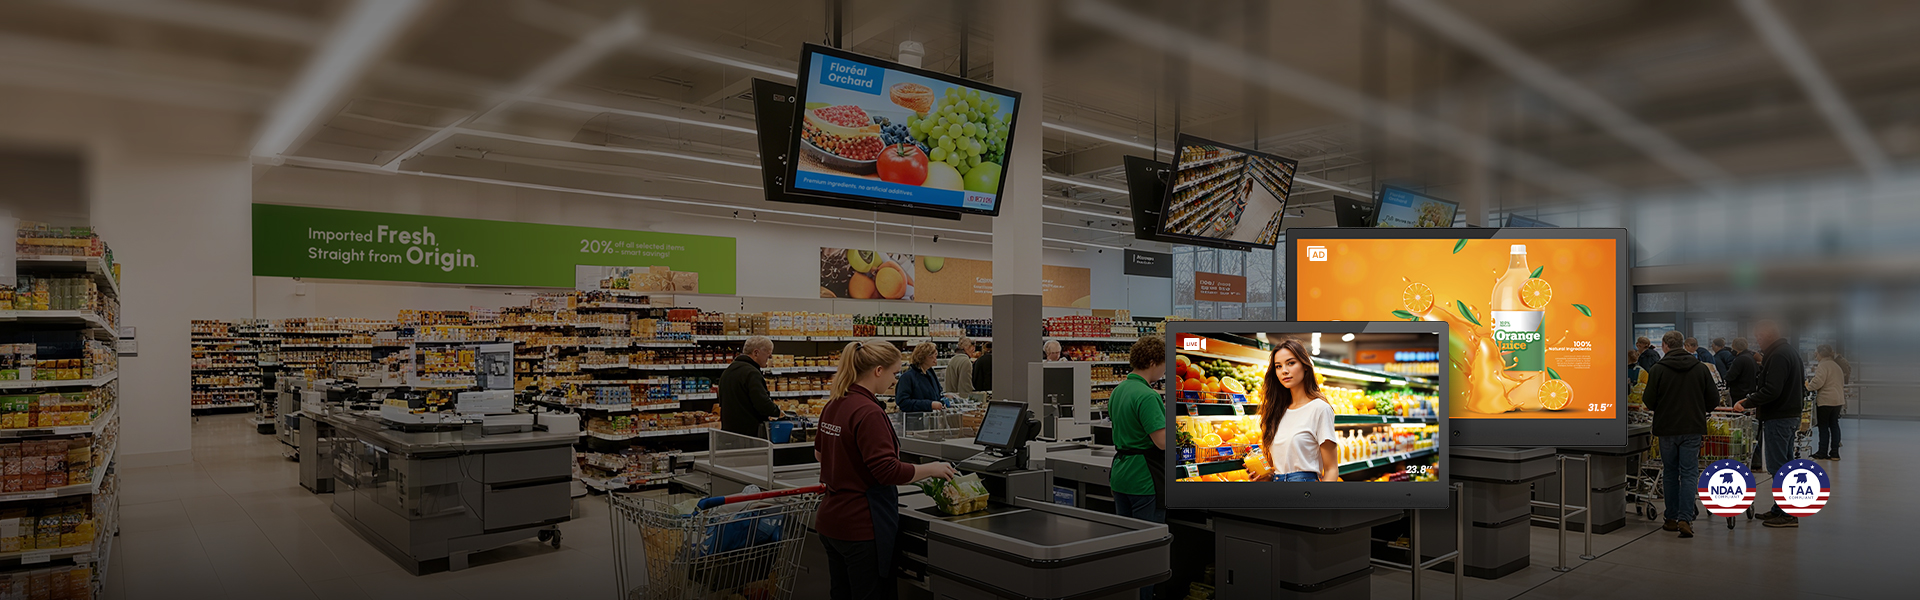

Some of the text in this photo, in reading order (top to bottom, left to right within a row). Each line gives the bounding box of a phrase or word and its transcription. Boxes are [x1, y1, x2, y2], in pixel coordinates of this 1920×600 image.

[830, 62, 867, 76] Floréal
[828, 73, 873, 88] Orchard
[803, 177, 826, 185] Premium
[827, 181, 857, 189] ingredients,
[888, 188, 913, 196] additives.
[308, 225, 439, 247] Imported Fresh,
[580, 238, 614, 254] 20%
[635, 242, 665, 250] selected
[308, 245, 479, 272] Straight from Origin.
[642, 250, 670, 259] savings!
[1312, 250, 1325, 258] AD
[1496, 330, 1541, 343] Orange
